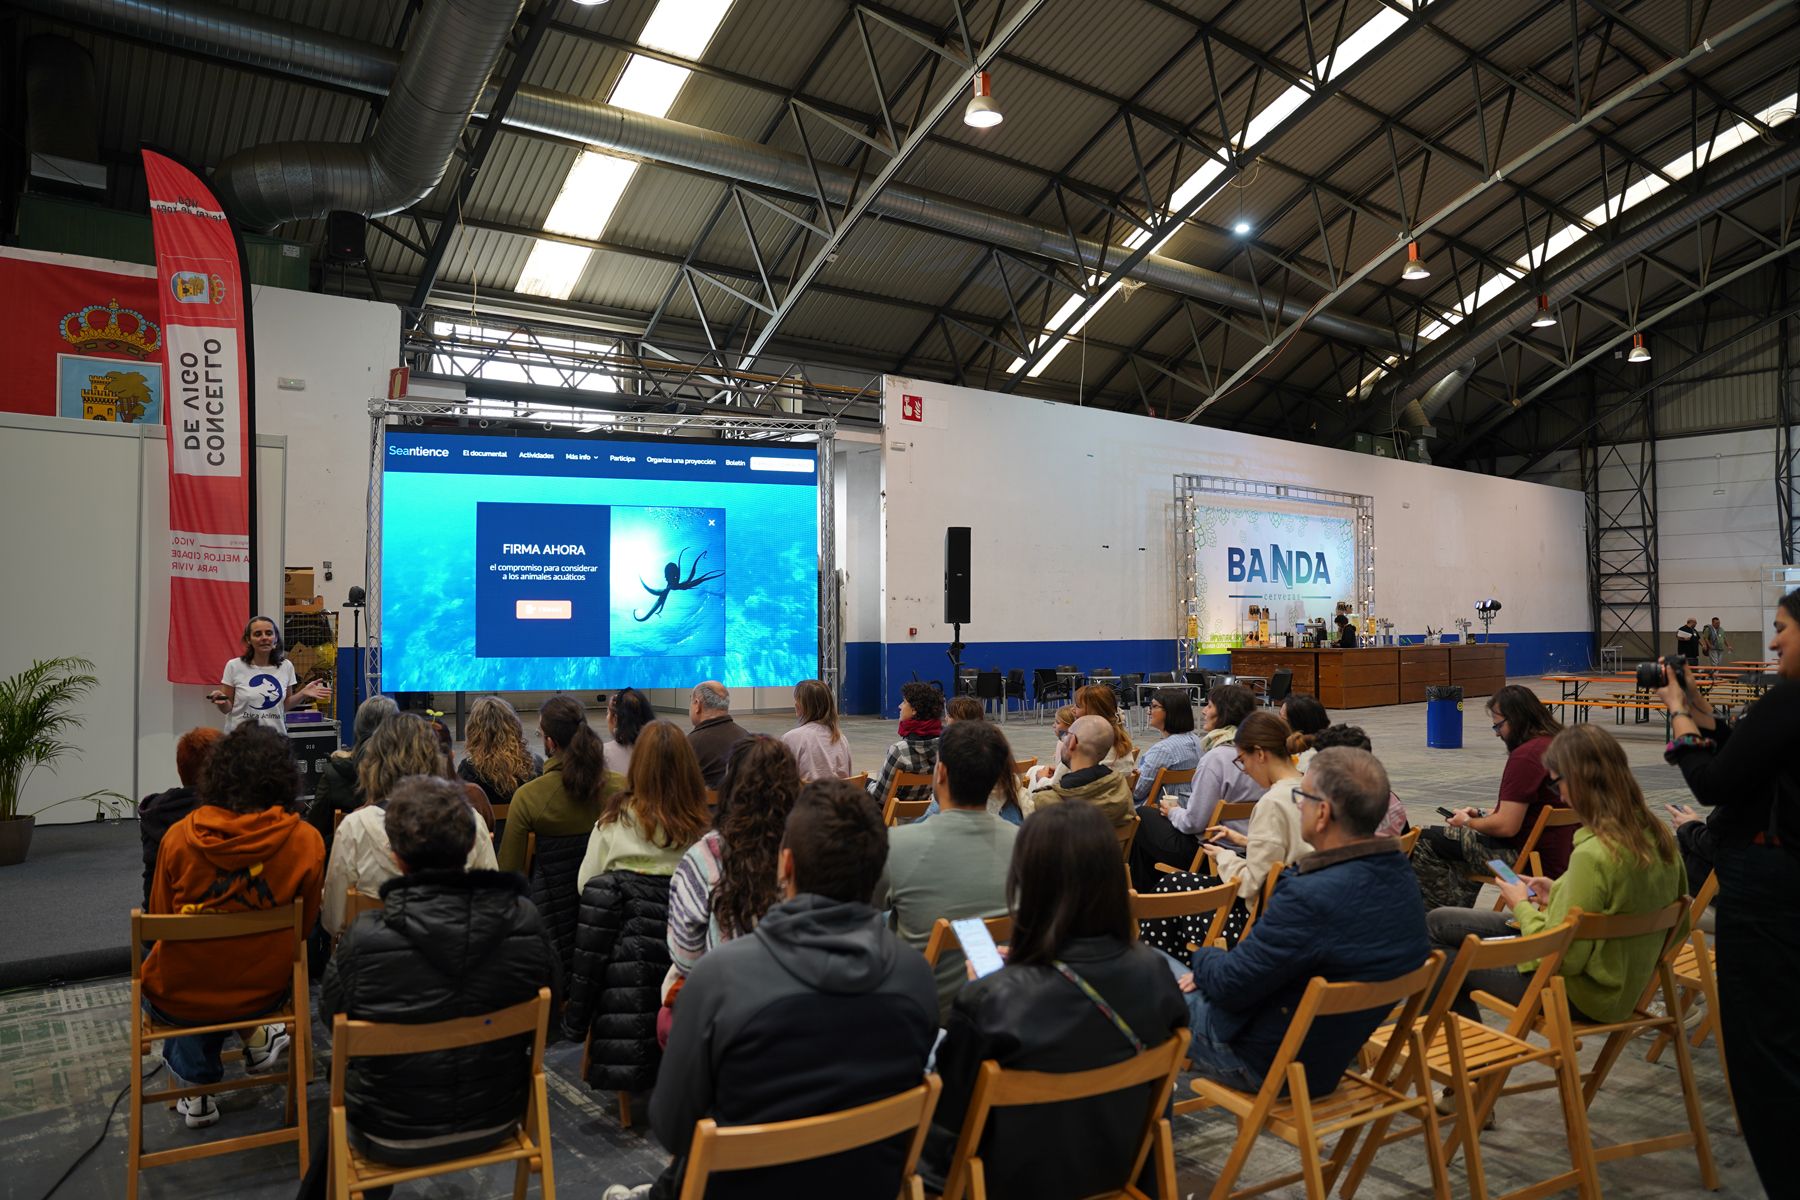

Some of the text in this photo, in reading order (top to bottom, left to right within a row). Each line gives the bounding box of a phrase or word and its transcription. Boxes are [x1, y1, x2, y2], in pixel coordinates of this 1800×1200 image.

[389, 445, 450, 458] Seantience
[463, 449, 508, 458] El documental
[519, 451, 555, 460] Actividades
[579, 453, 591, 461] info
[610, 455, 635, 463] Participa
[646, 456, 672, 465] Organiza
[685, 459, 717, 467] proyección
[725, 459, 746, 468] Boletín
[503, 544, 586, 555] FIRMA AHORA
[490, 564, 497, 572] el
[498, 564, 542, 573] compromiso
[561, 565, 598, 573] considerar
[1228, 543, 1331, 590] BANDA
